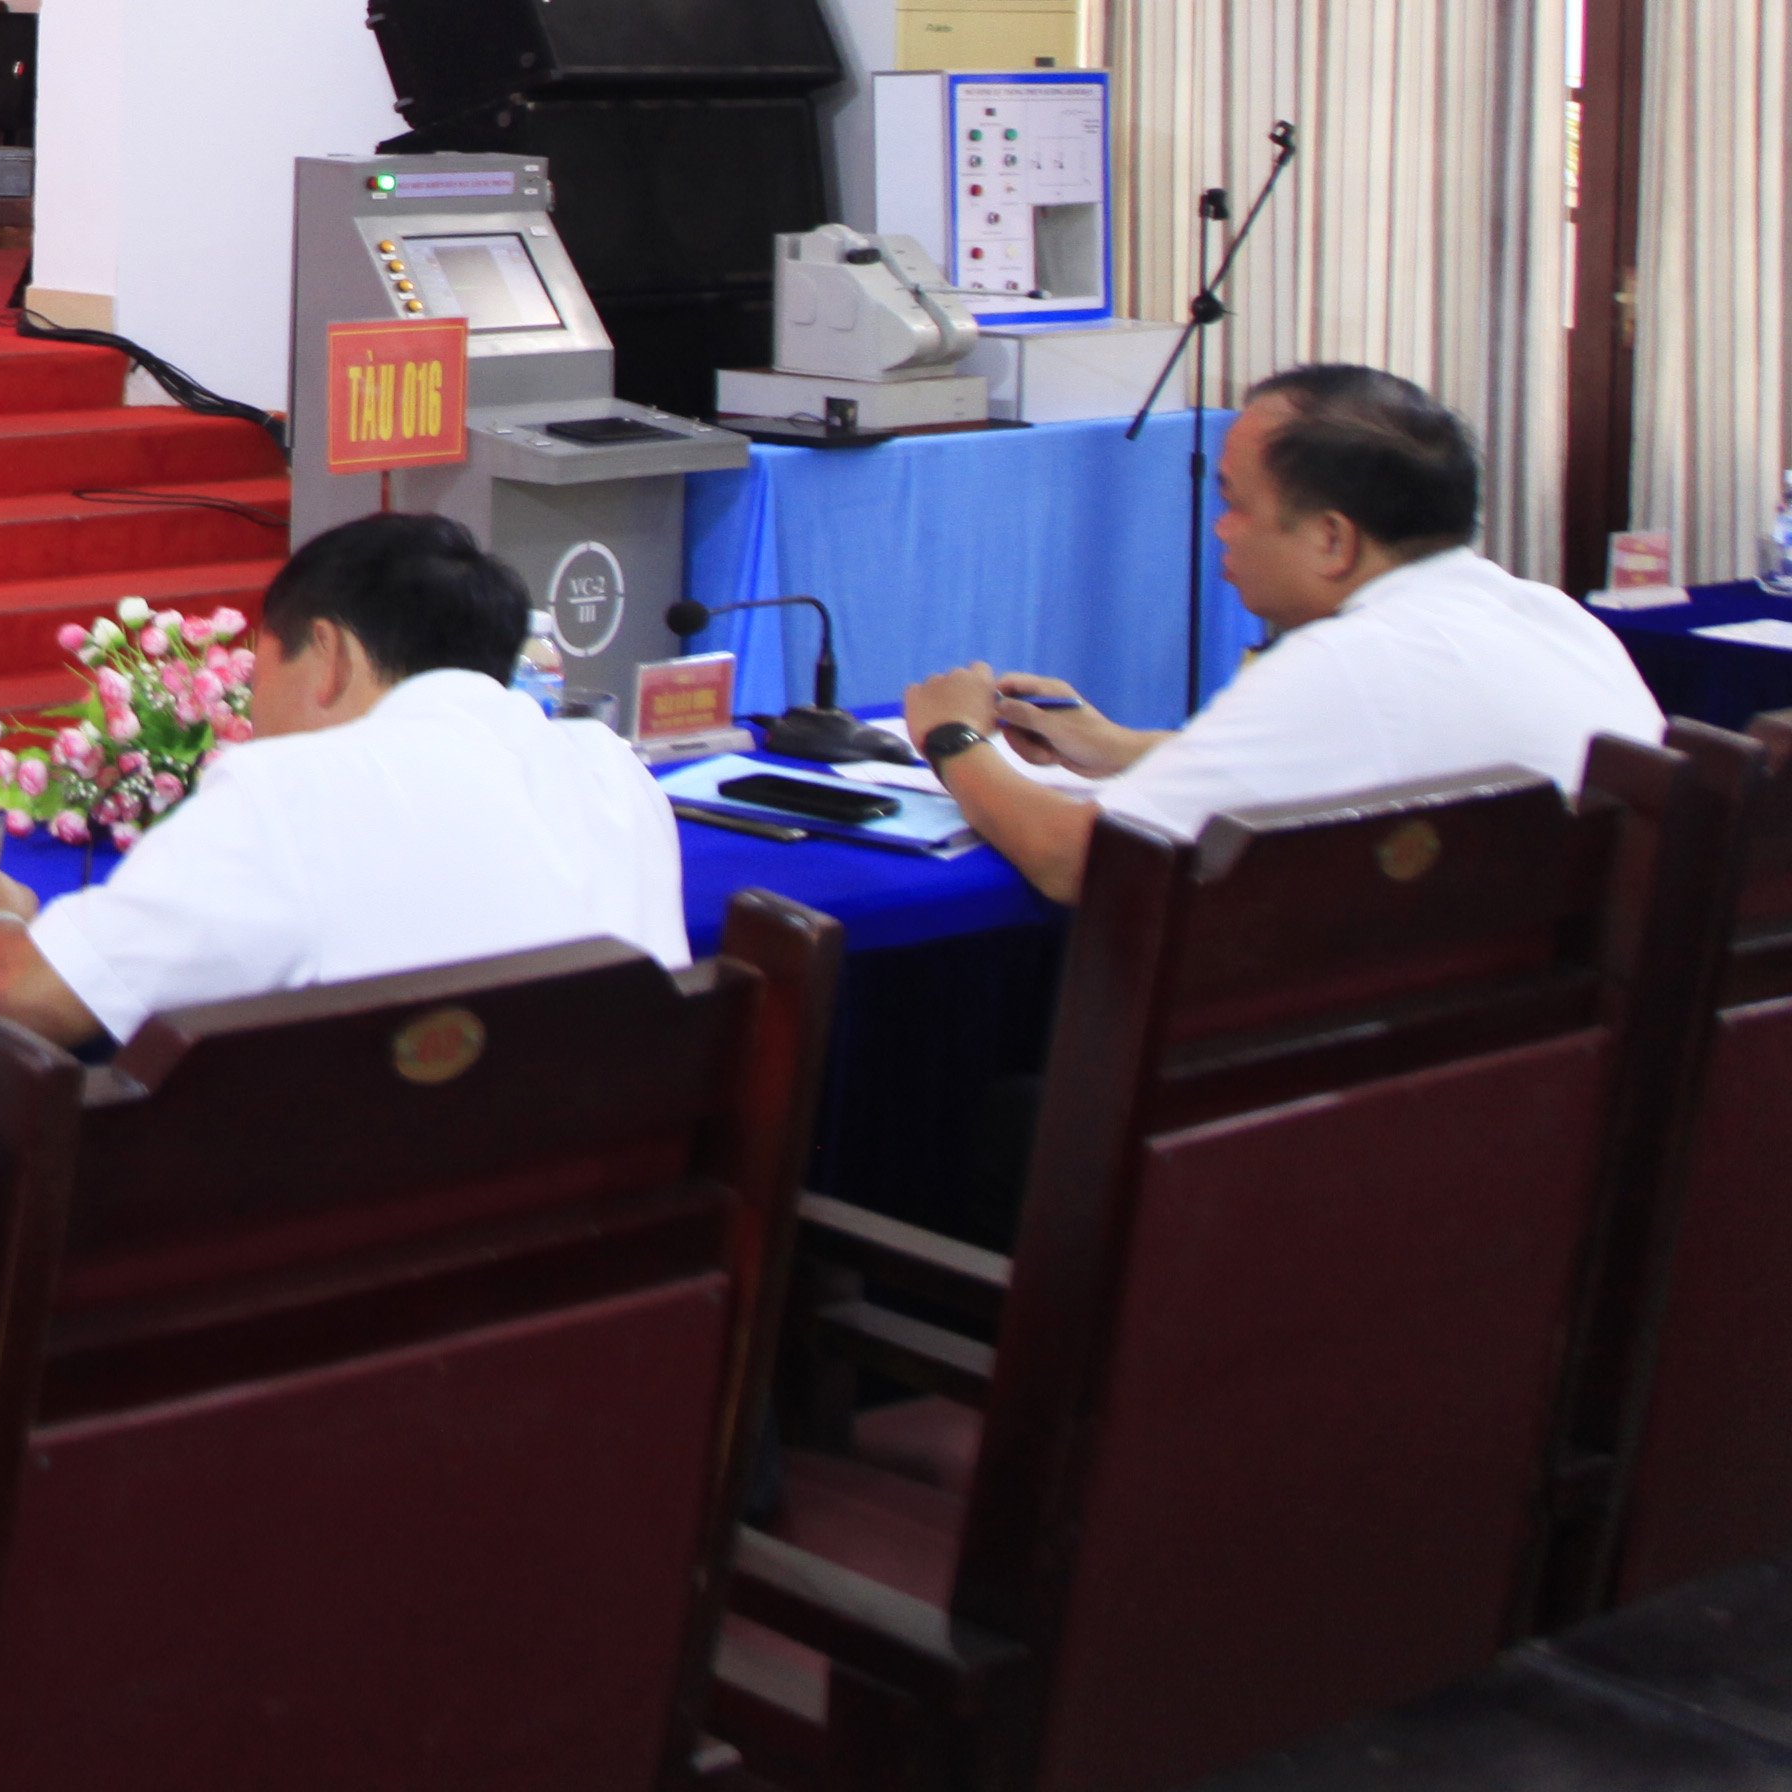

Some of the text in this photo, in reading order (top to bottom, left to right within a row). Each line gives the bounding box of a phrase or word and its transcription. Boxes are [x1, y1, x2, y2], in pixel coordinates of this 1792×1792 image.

[347, 349, 443, 442] TÀU 016
[570, 575, 606, 595] VC-2
